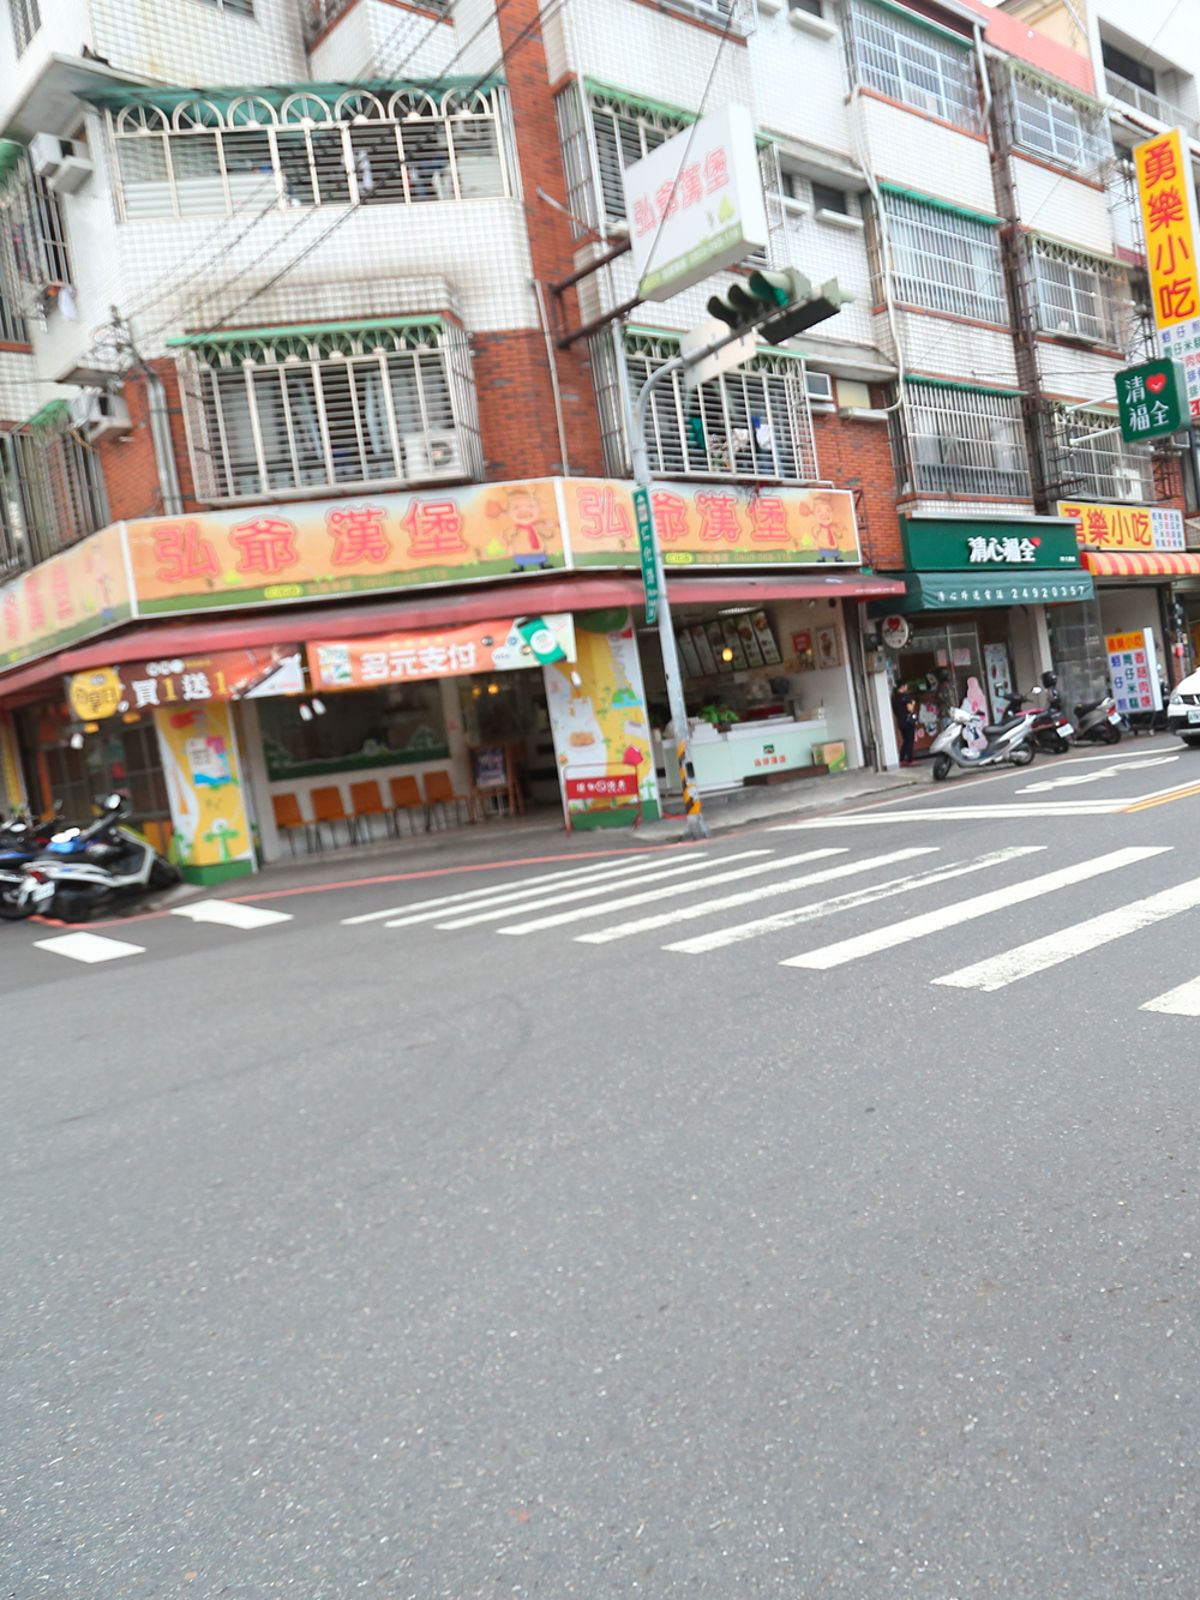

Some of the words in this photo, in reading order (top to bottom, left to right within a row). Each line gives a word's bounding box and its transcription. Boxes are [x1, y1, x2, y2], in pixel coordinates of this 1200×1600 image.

[1144, 139, 1196, 320] 勇樂小吃
[1129, 400, 1170, 432] 福全
[575, 485, 792, 543] 弘爺漢堡
[152, 498, 470, 584] 弘爺漢堡
[967, 536, 1037, 563] 清心福全
[360, 641, 477, 680] 多元支付
[132, 671, 228, 707] 買1送1
